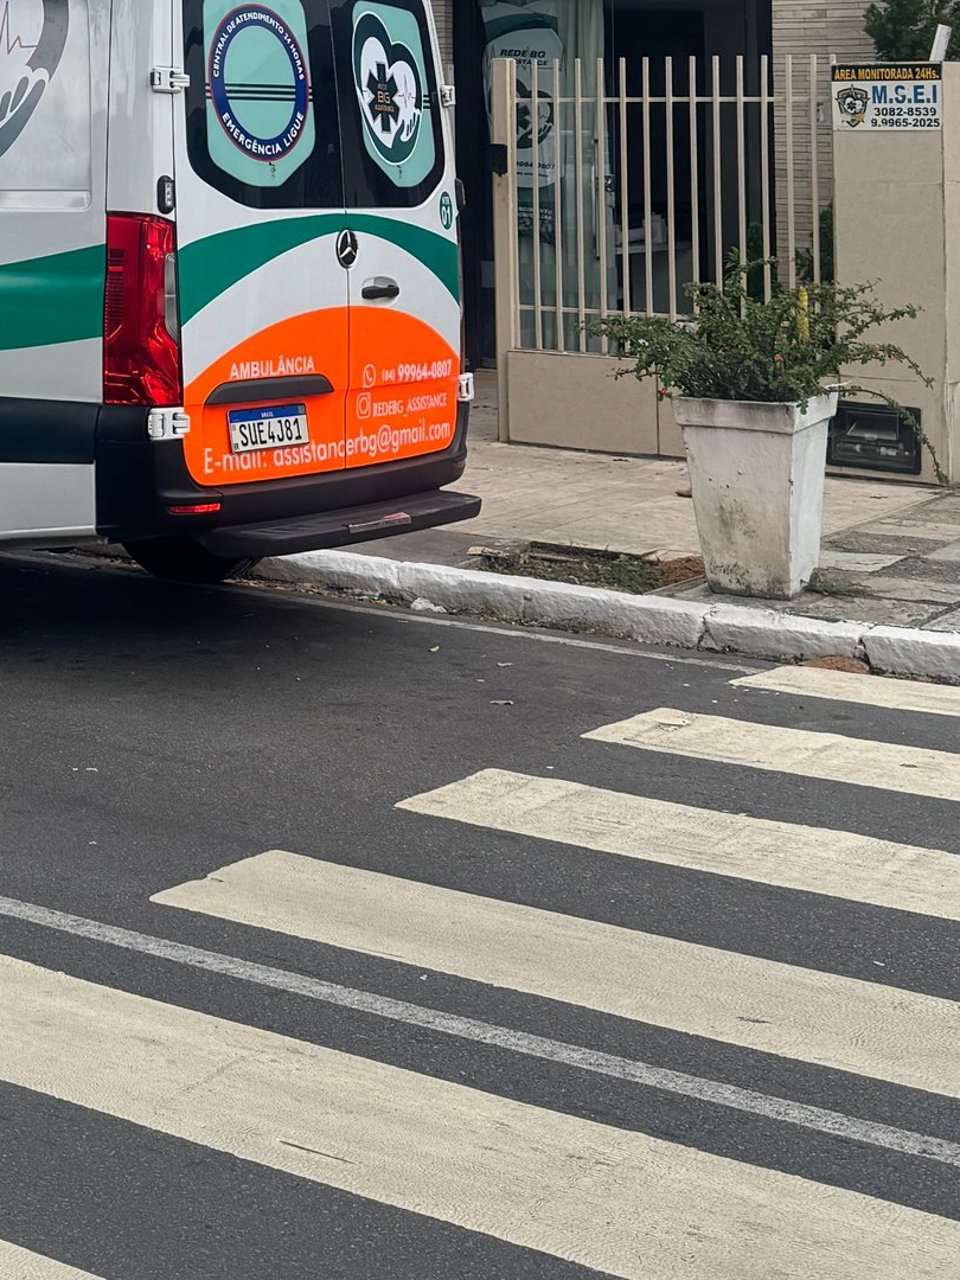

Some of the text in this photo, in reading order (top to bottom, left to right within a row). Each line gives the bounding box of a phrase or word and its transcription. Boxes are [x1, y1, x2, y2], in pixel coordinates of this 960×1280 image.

[213, 12, 304, 80] CENTRAL DE ATENDIMENTO 24 HORAS
[834, 68, 857, 80] AREA
[858, 68, 914, 80] MONITORADA
[377, 90, 391, 104] BG
[872, 85, 938, 104] M.S.E.I
[874, 107, 937, 117] 3082-8539
[222, 111, 305, 155] EMERGÊNCIA LIGUE
[230, 355, 315, 379] AMBULÂNCIA
[398, 359, 452, 382] 99964-0807
[373, 392, 447, 417] REDEBG_ASSISTANCE
[239, 418, 302, 446] SUE4J81
[204, 417, 450, 475] E-mail: assistancerbg@gmail.com
